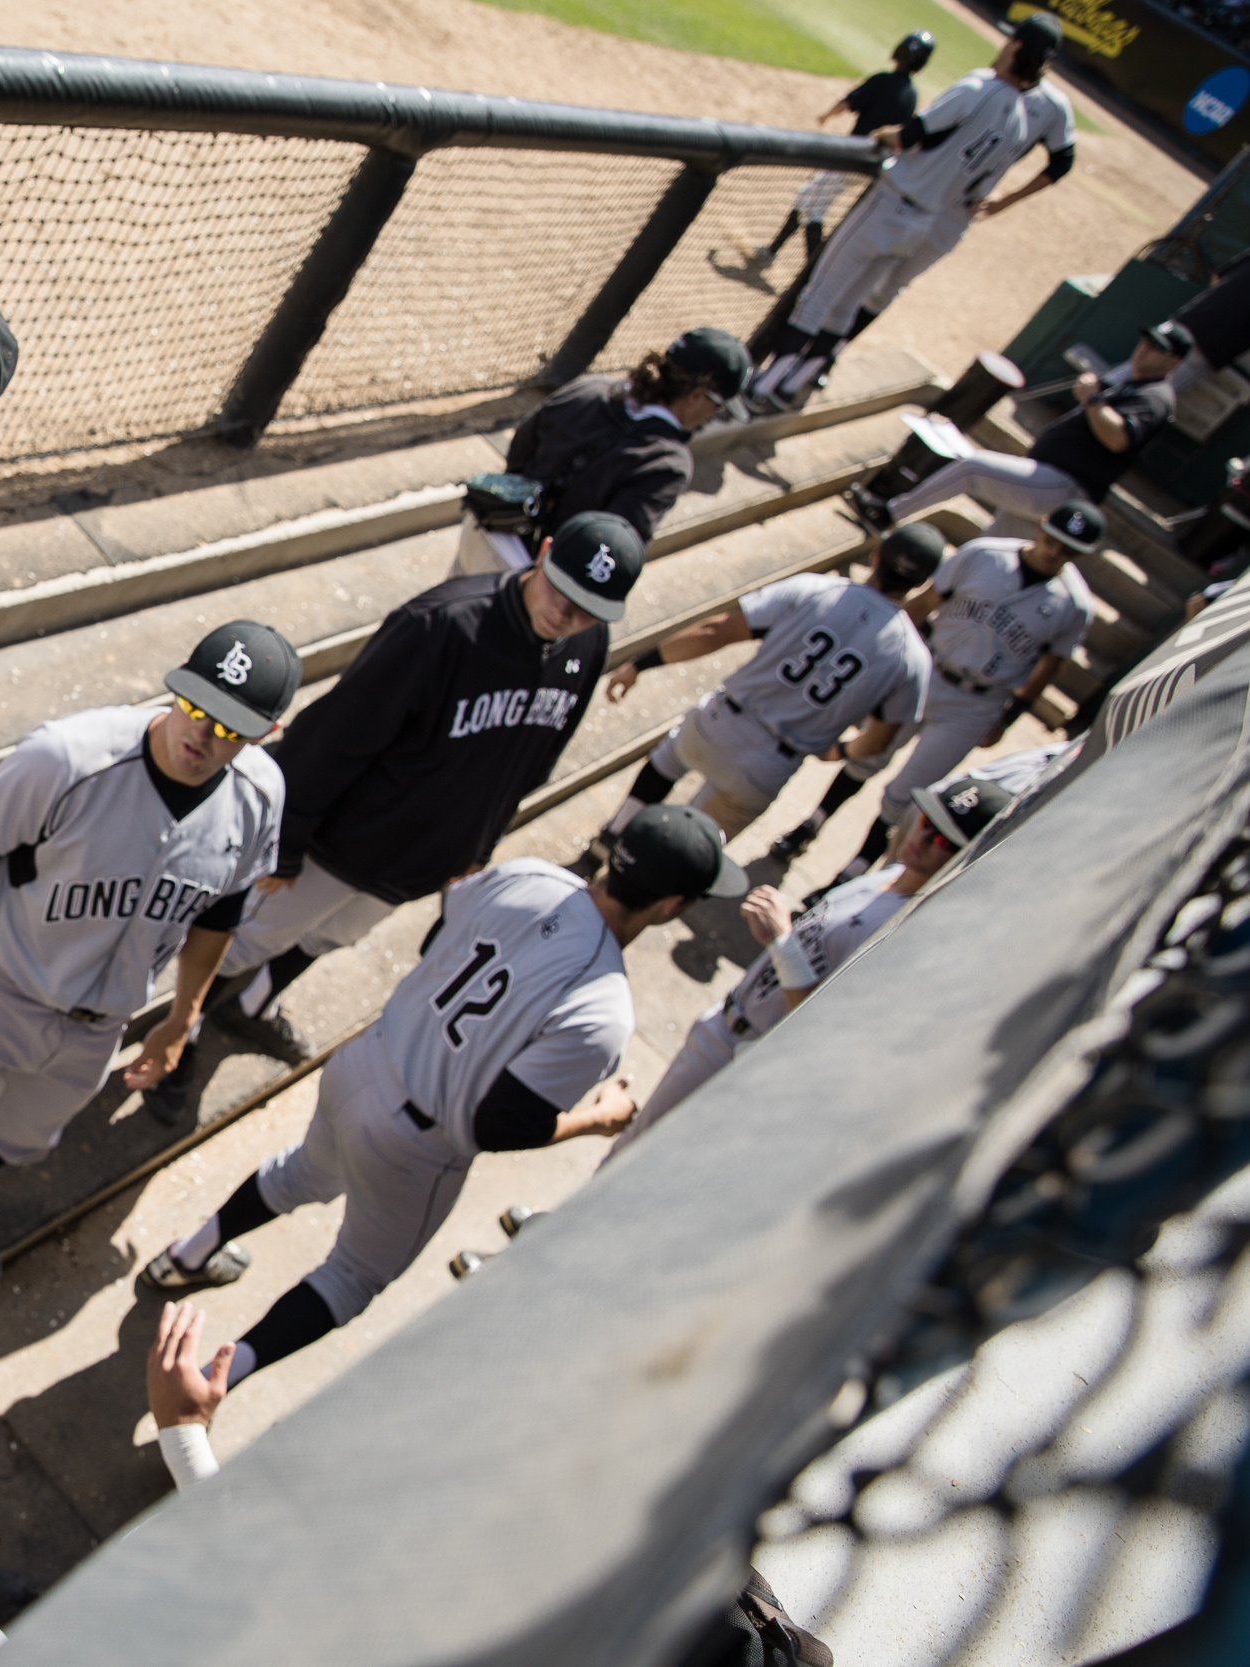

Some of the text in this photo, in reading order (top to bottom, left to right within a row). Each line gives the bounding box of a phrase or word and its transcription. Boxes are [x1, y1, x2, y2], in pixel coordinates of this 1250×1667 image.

[778, 628, 866, 707] 33
[450, 691, 529, 737] LONG
[44, 875, 146, 924] LONG
[431, 938, 513, 1052] 12
